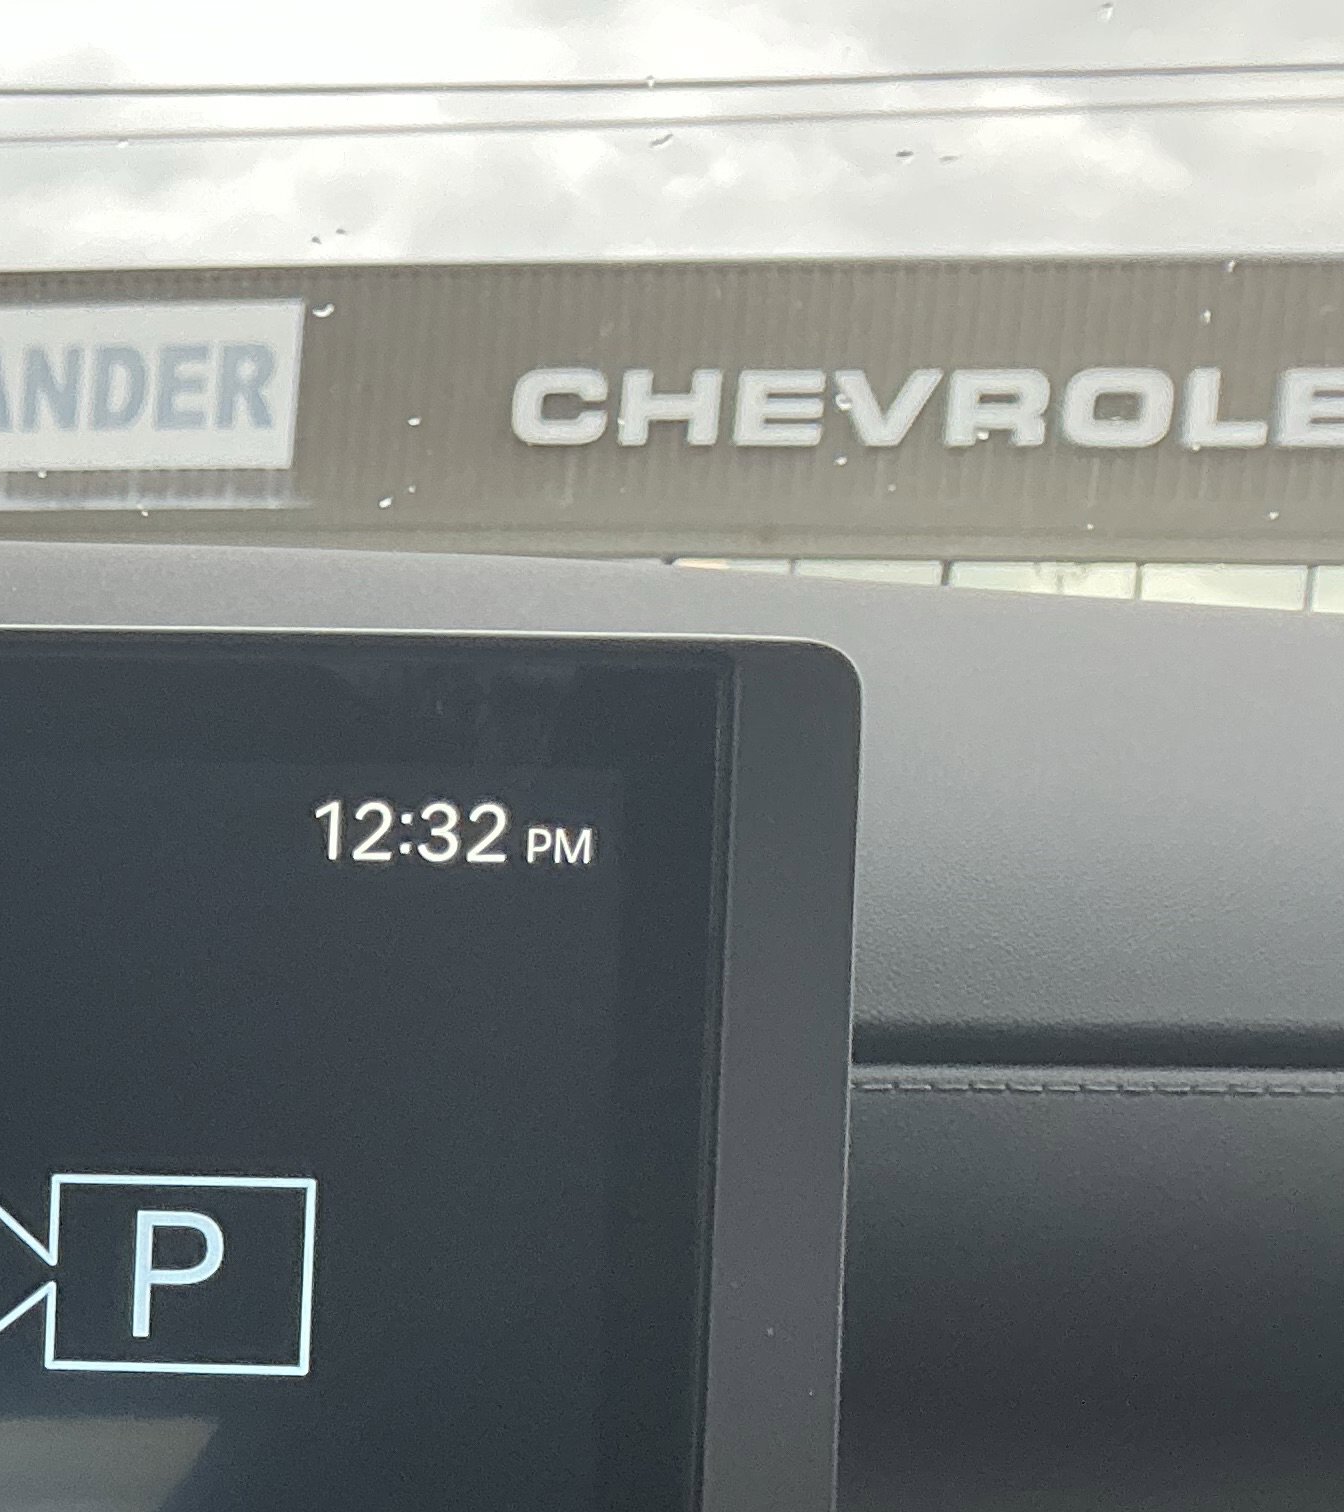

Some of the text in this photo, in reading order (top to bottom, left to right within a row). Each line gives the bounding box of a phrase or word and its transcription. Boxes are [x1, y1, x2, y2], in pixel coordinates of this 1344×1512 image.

[512, 367, 1344, 449] CHEVROLE
[315, 800, 593, 865] 12:32 PM
[131, 1209, 225, 1338] P
